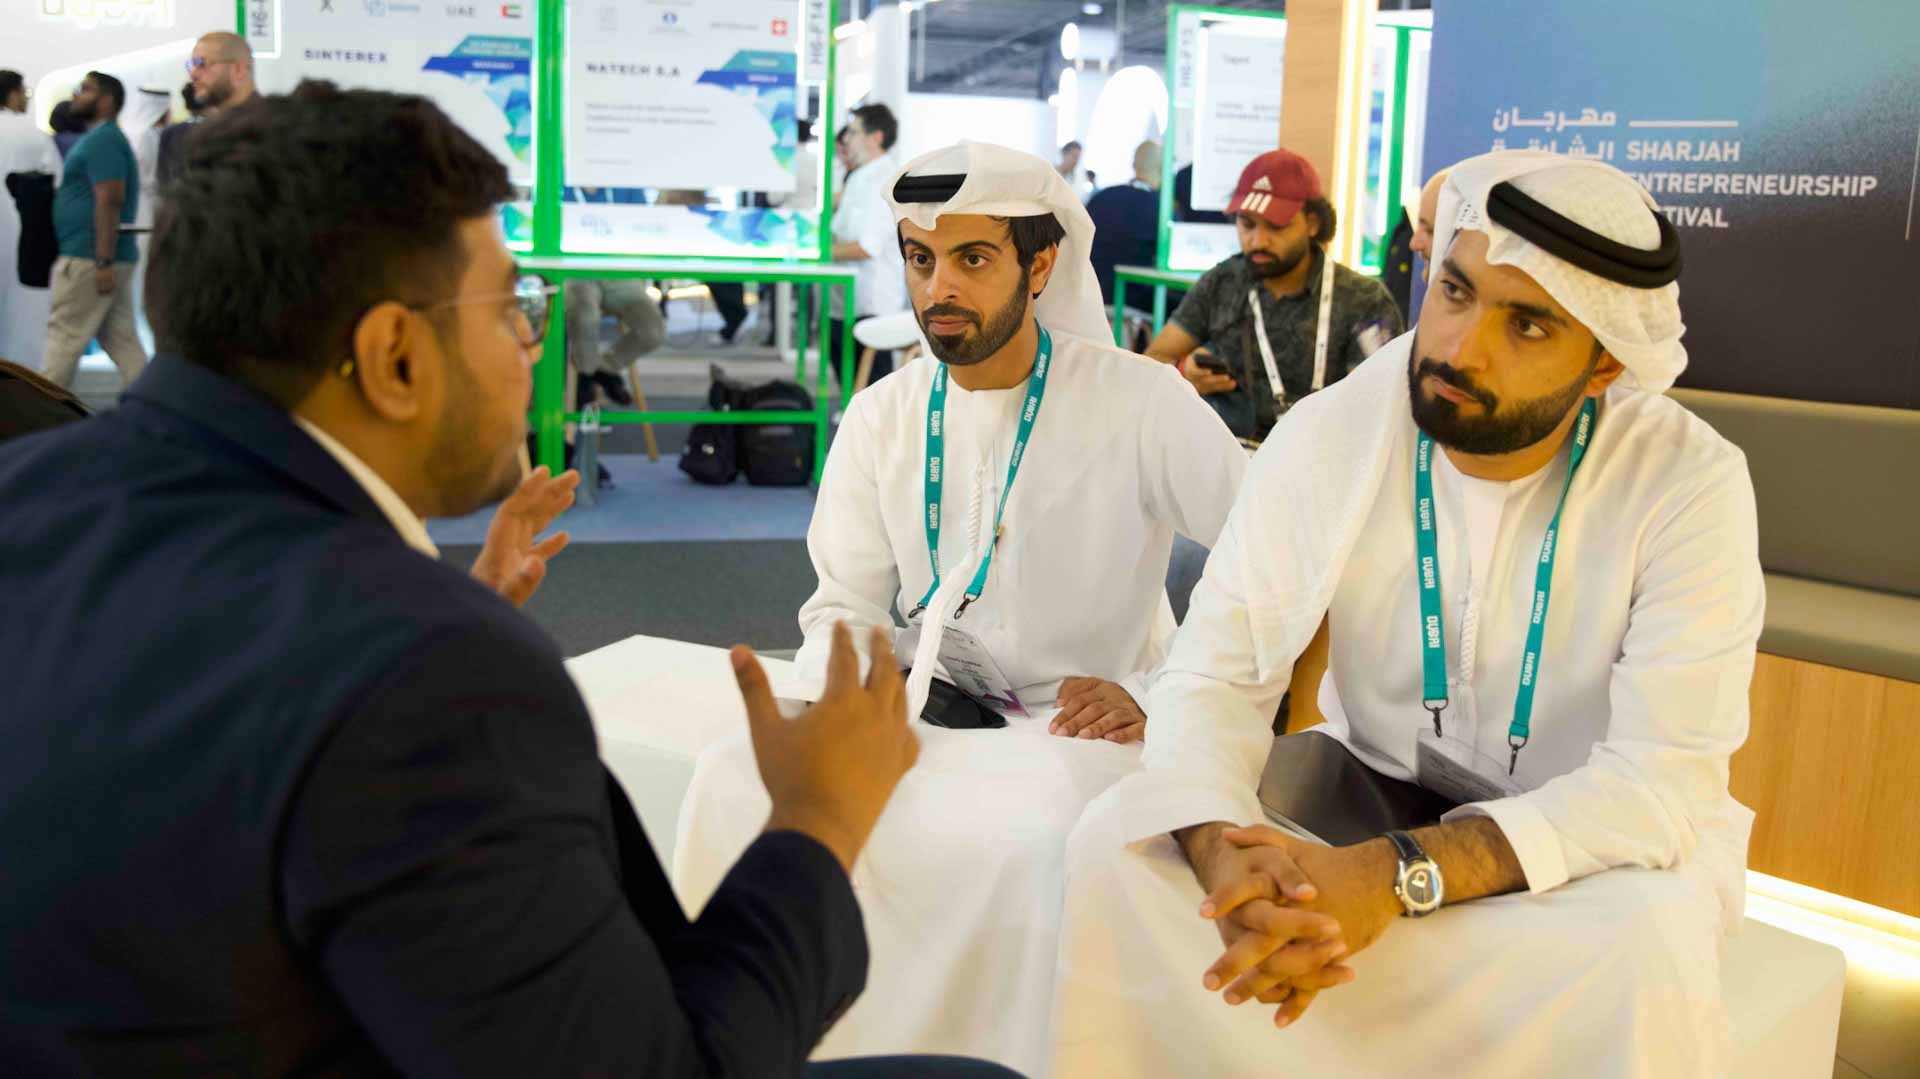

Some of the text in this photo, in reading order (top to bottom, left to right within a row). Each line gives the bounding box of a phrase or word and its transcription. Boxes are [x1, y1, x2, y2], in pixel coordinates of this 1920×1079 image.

[304, 50, 387, 62] SINTEREX
[586, 63, 650, 75] NATECH
[1493, 106, 1617, 132] مهرجان
[1626, 140, 1741, 161] SHARJAH
[1662, 205, 1729, 228] TIVAL
[1024, 396, 1037, 422] DUBAI
[1576, 413, 1590, 446] DUBAI
[1419, 498, 1431, 530] DUBAI
[1423, 556, 1435, 589] DUBAI
[1533, 591, 1545, 624] DUBAI
[1426, 615, 1440, 648] DUBAI
[1522, 652, 1535, 686] DUBAI
